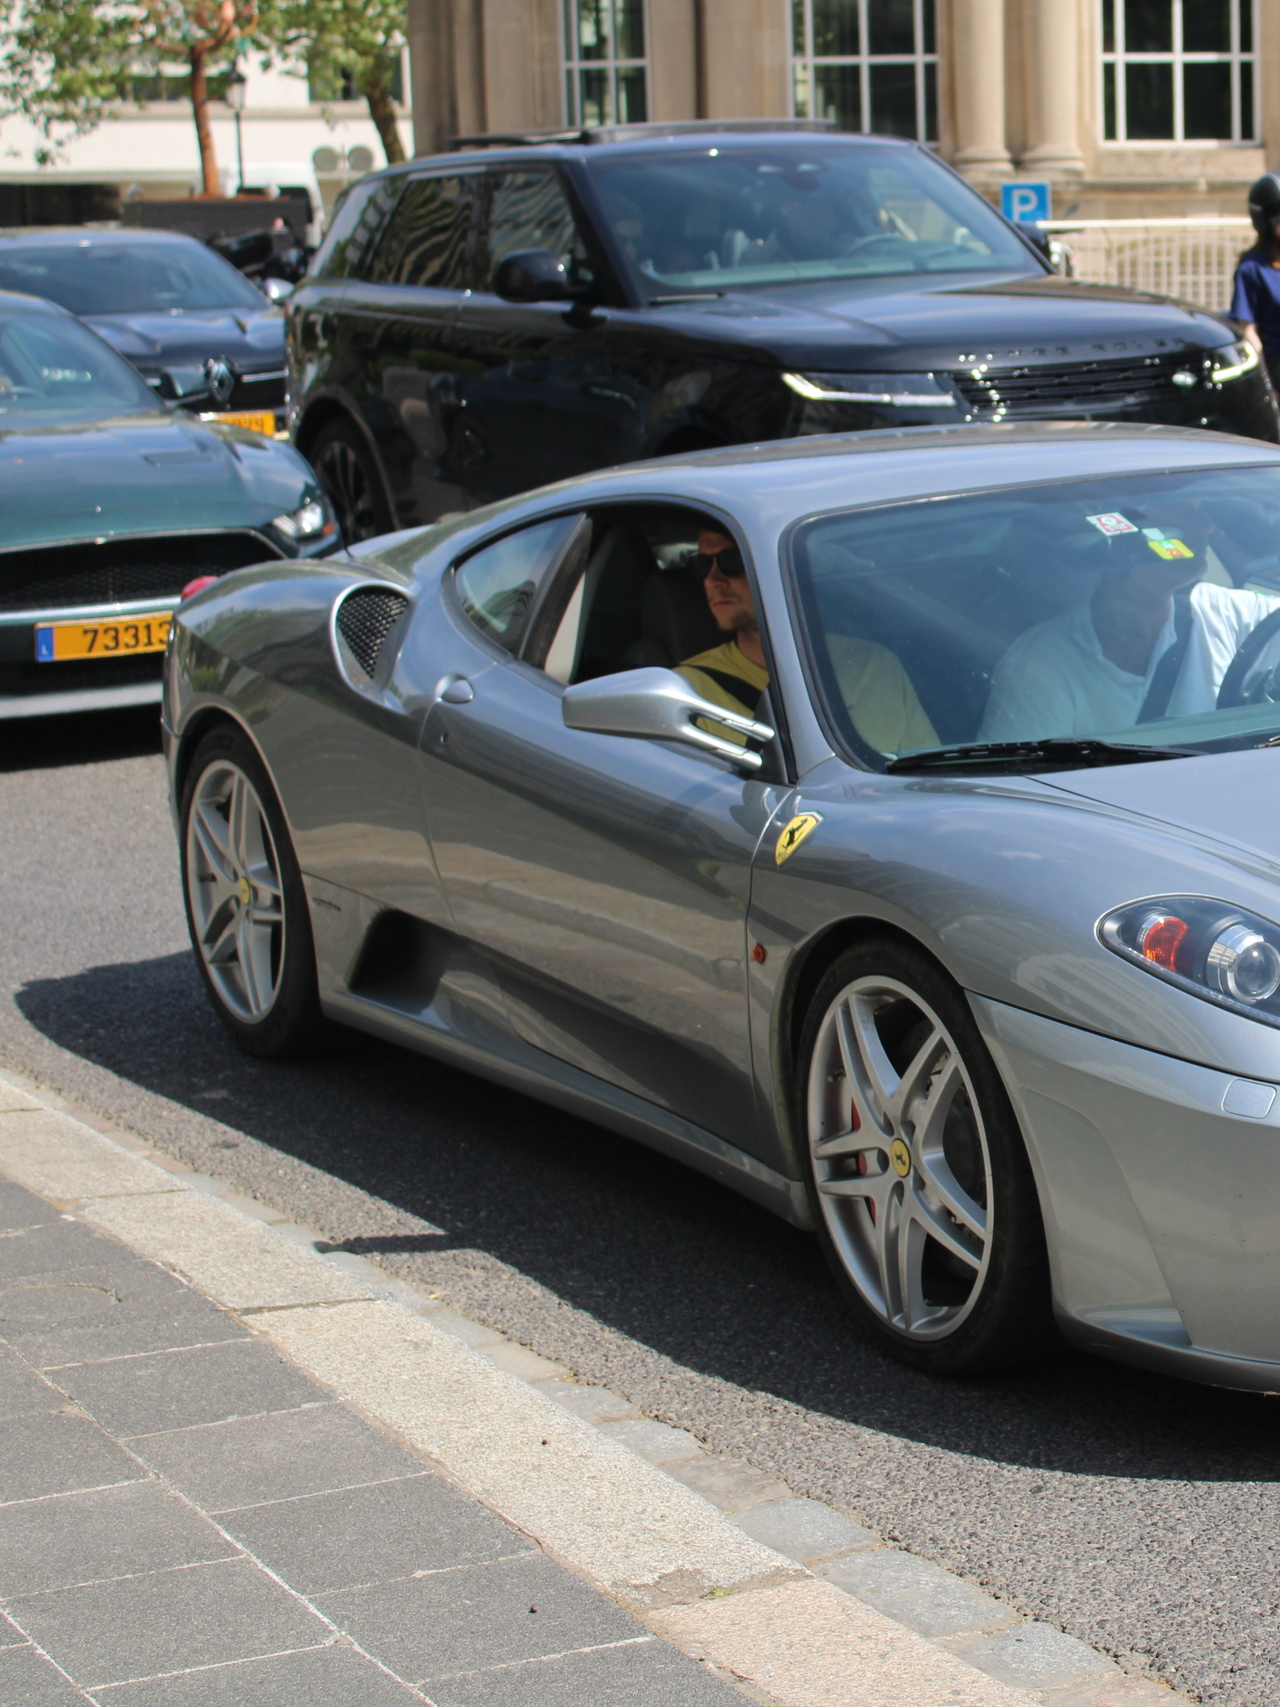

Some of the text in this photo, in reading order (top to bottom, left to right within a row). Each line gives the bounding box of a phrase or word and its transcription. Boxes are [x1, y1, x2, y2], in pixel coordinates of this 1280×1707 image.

[1012, 188, 1038, 223] P
[41, 620, 173, 655] L 73313
